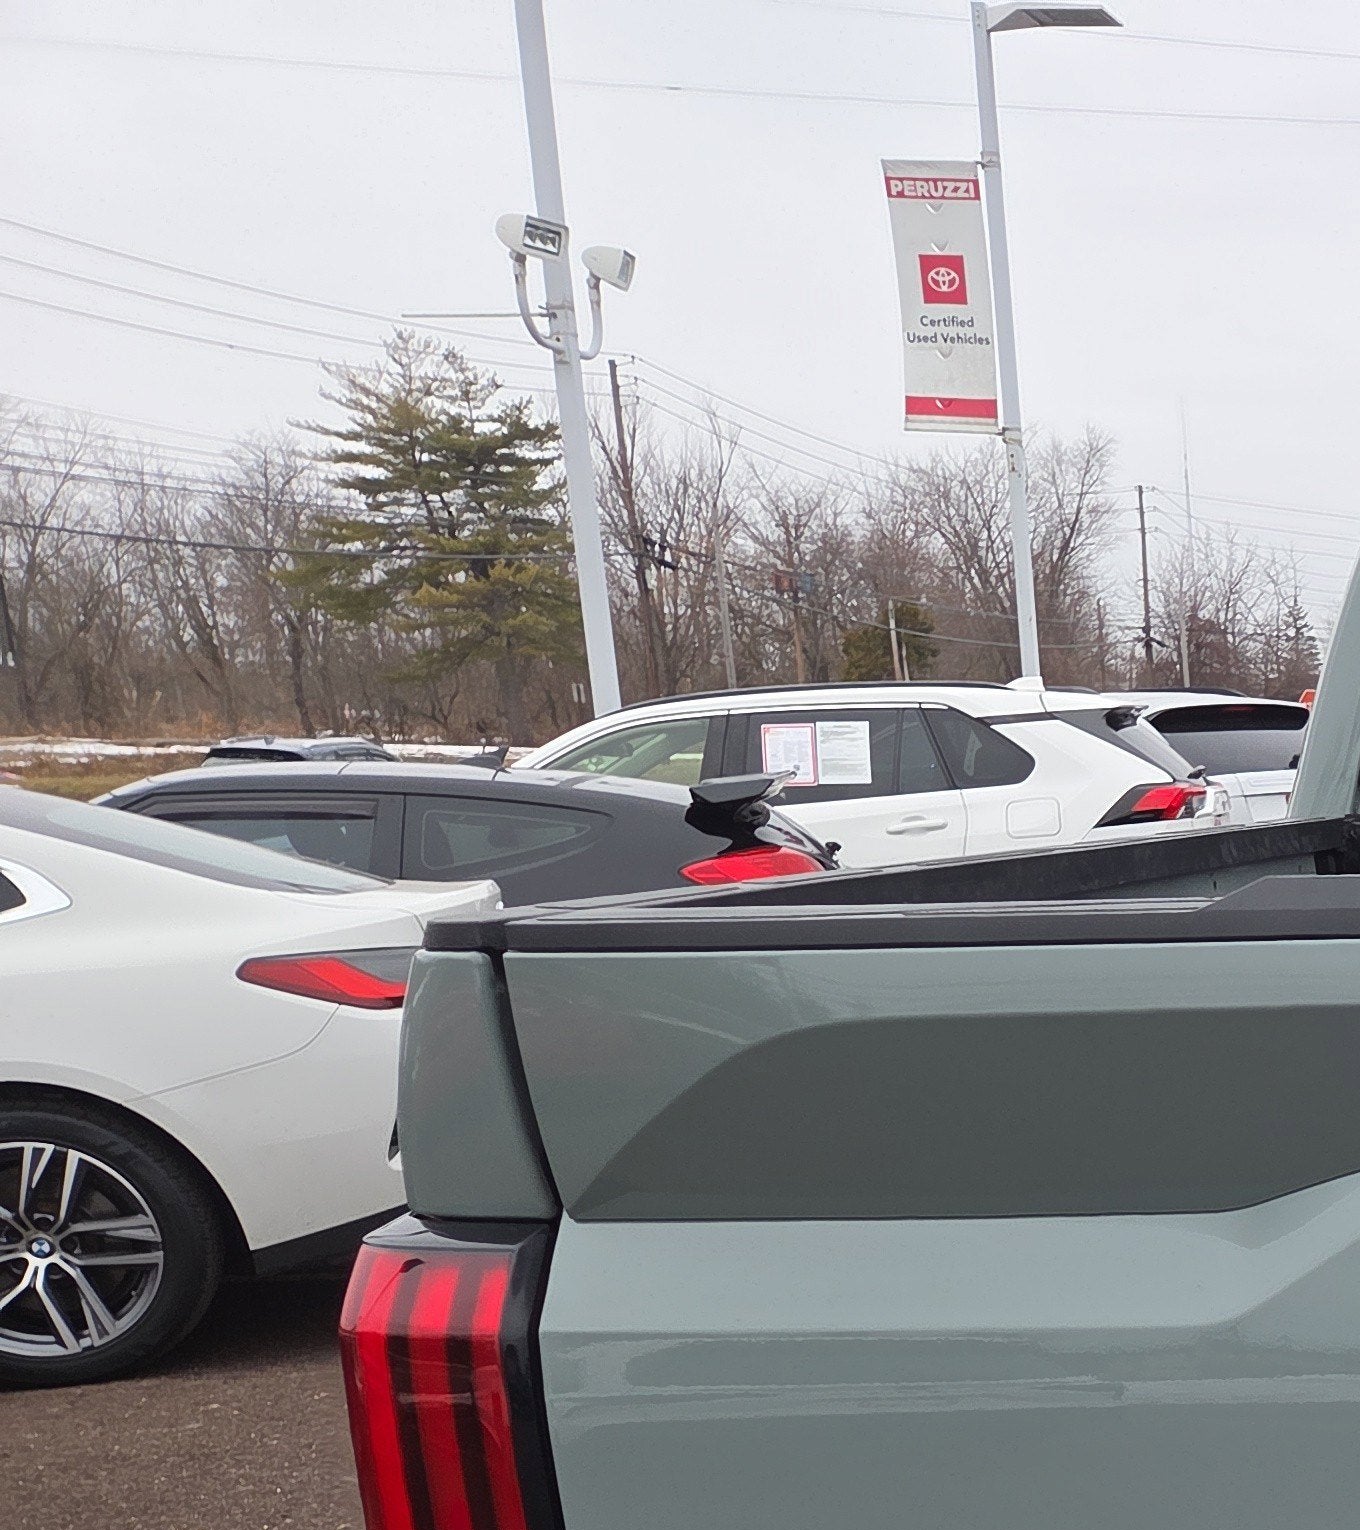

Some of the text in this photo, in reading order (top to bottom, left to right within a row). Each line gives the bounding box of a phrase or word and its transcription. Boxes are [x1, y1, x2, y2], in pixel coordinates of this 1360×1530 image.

[889, 179, 976, 199] PERUZZI
[919, 315, 975, 329] Certified
[906, 331, 991, 346] Used Vehicles
